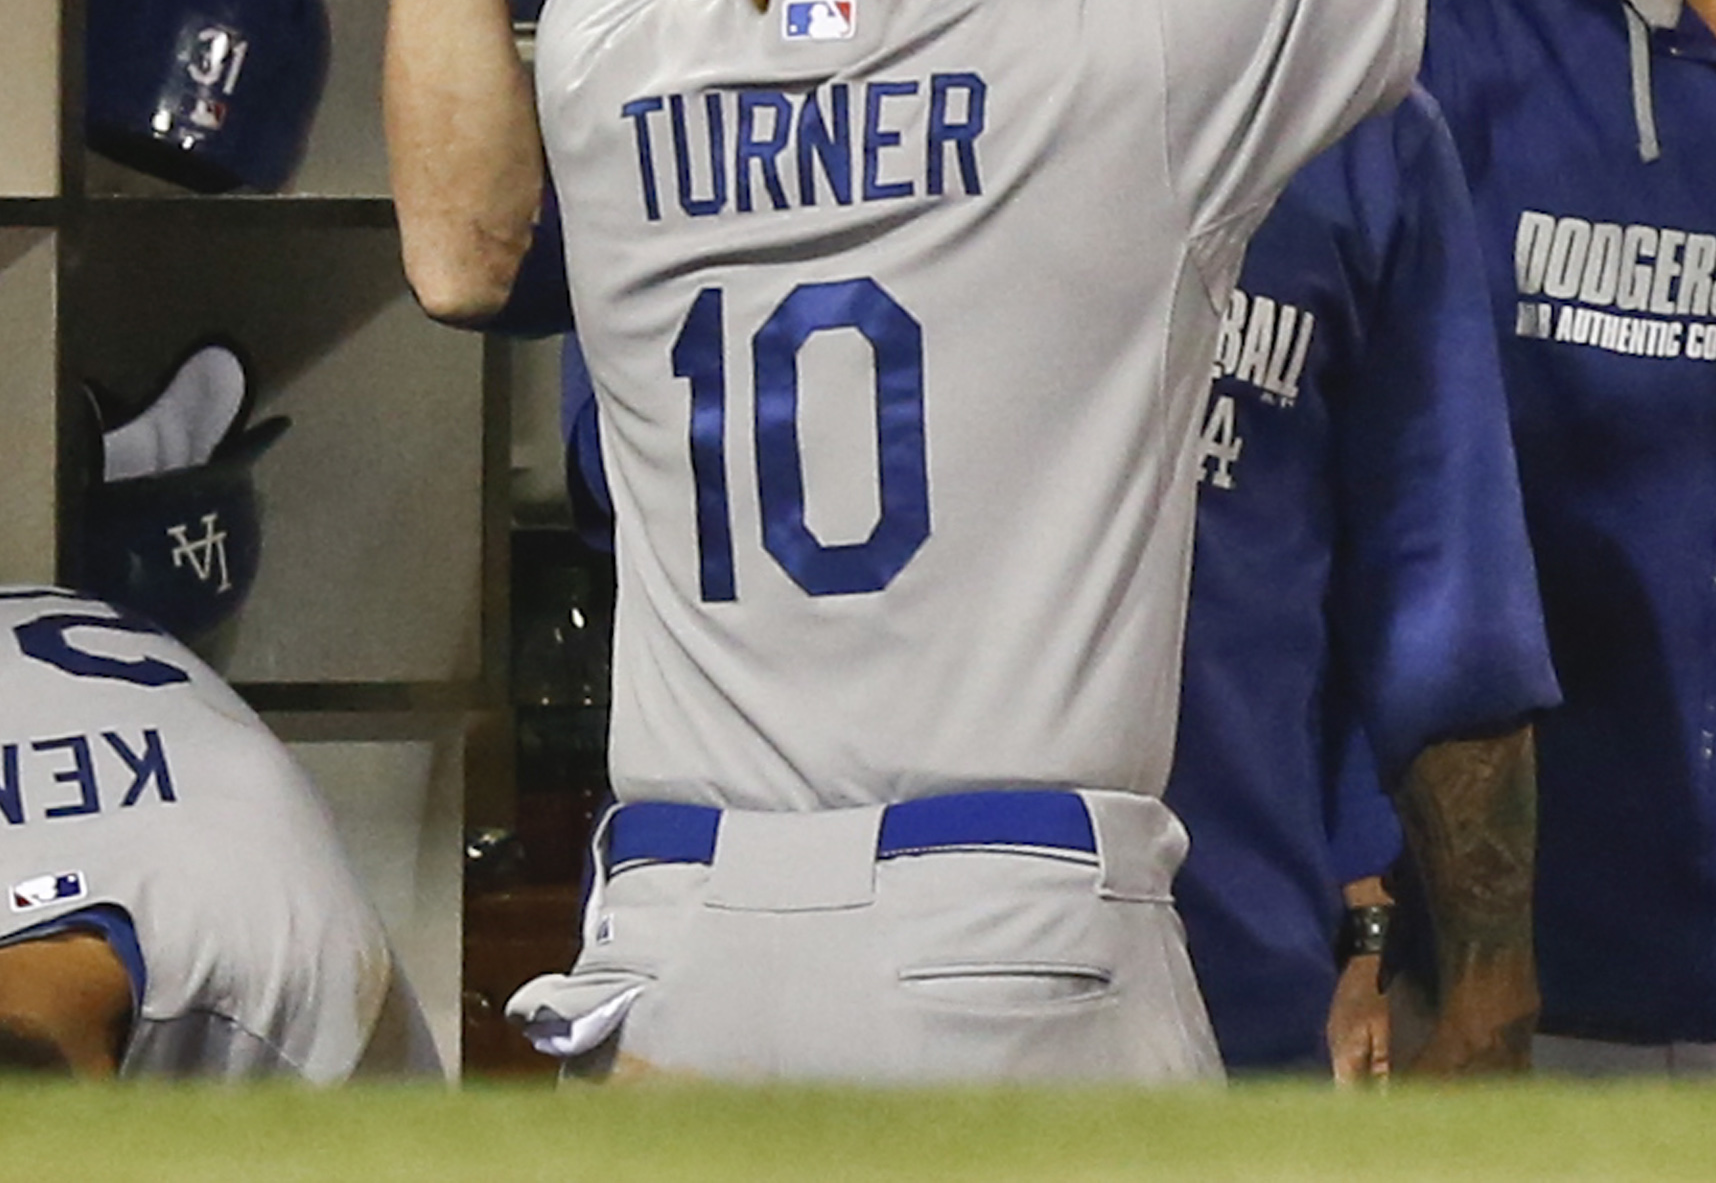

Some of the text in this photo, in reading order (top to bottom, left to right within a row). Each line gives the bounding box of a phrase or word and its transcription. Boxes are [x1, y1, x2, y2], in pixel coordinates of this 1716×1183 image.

[187, 27, 248, 96] 31
[621, 72, 988, 221] TURNER
[1212, 288, 1315, 399] BALL
[1555, 305, 1684, 358] AUTHENTIC
[671, 276, 932, 603] 10
